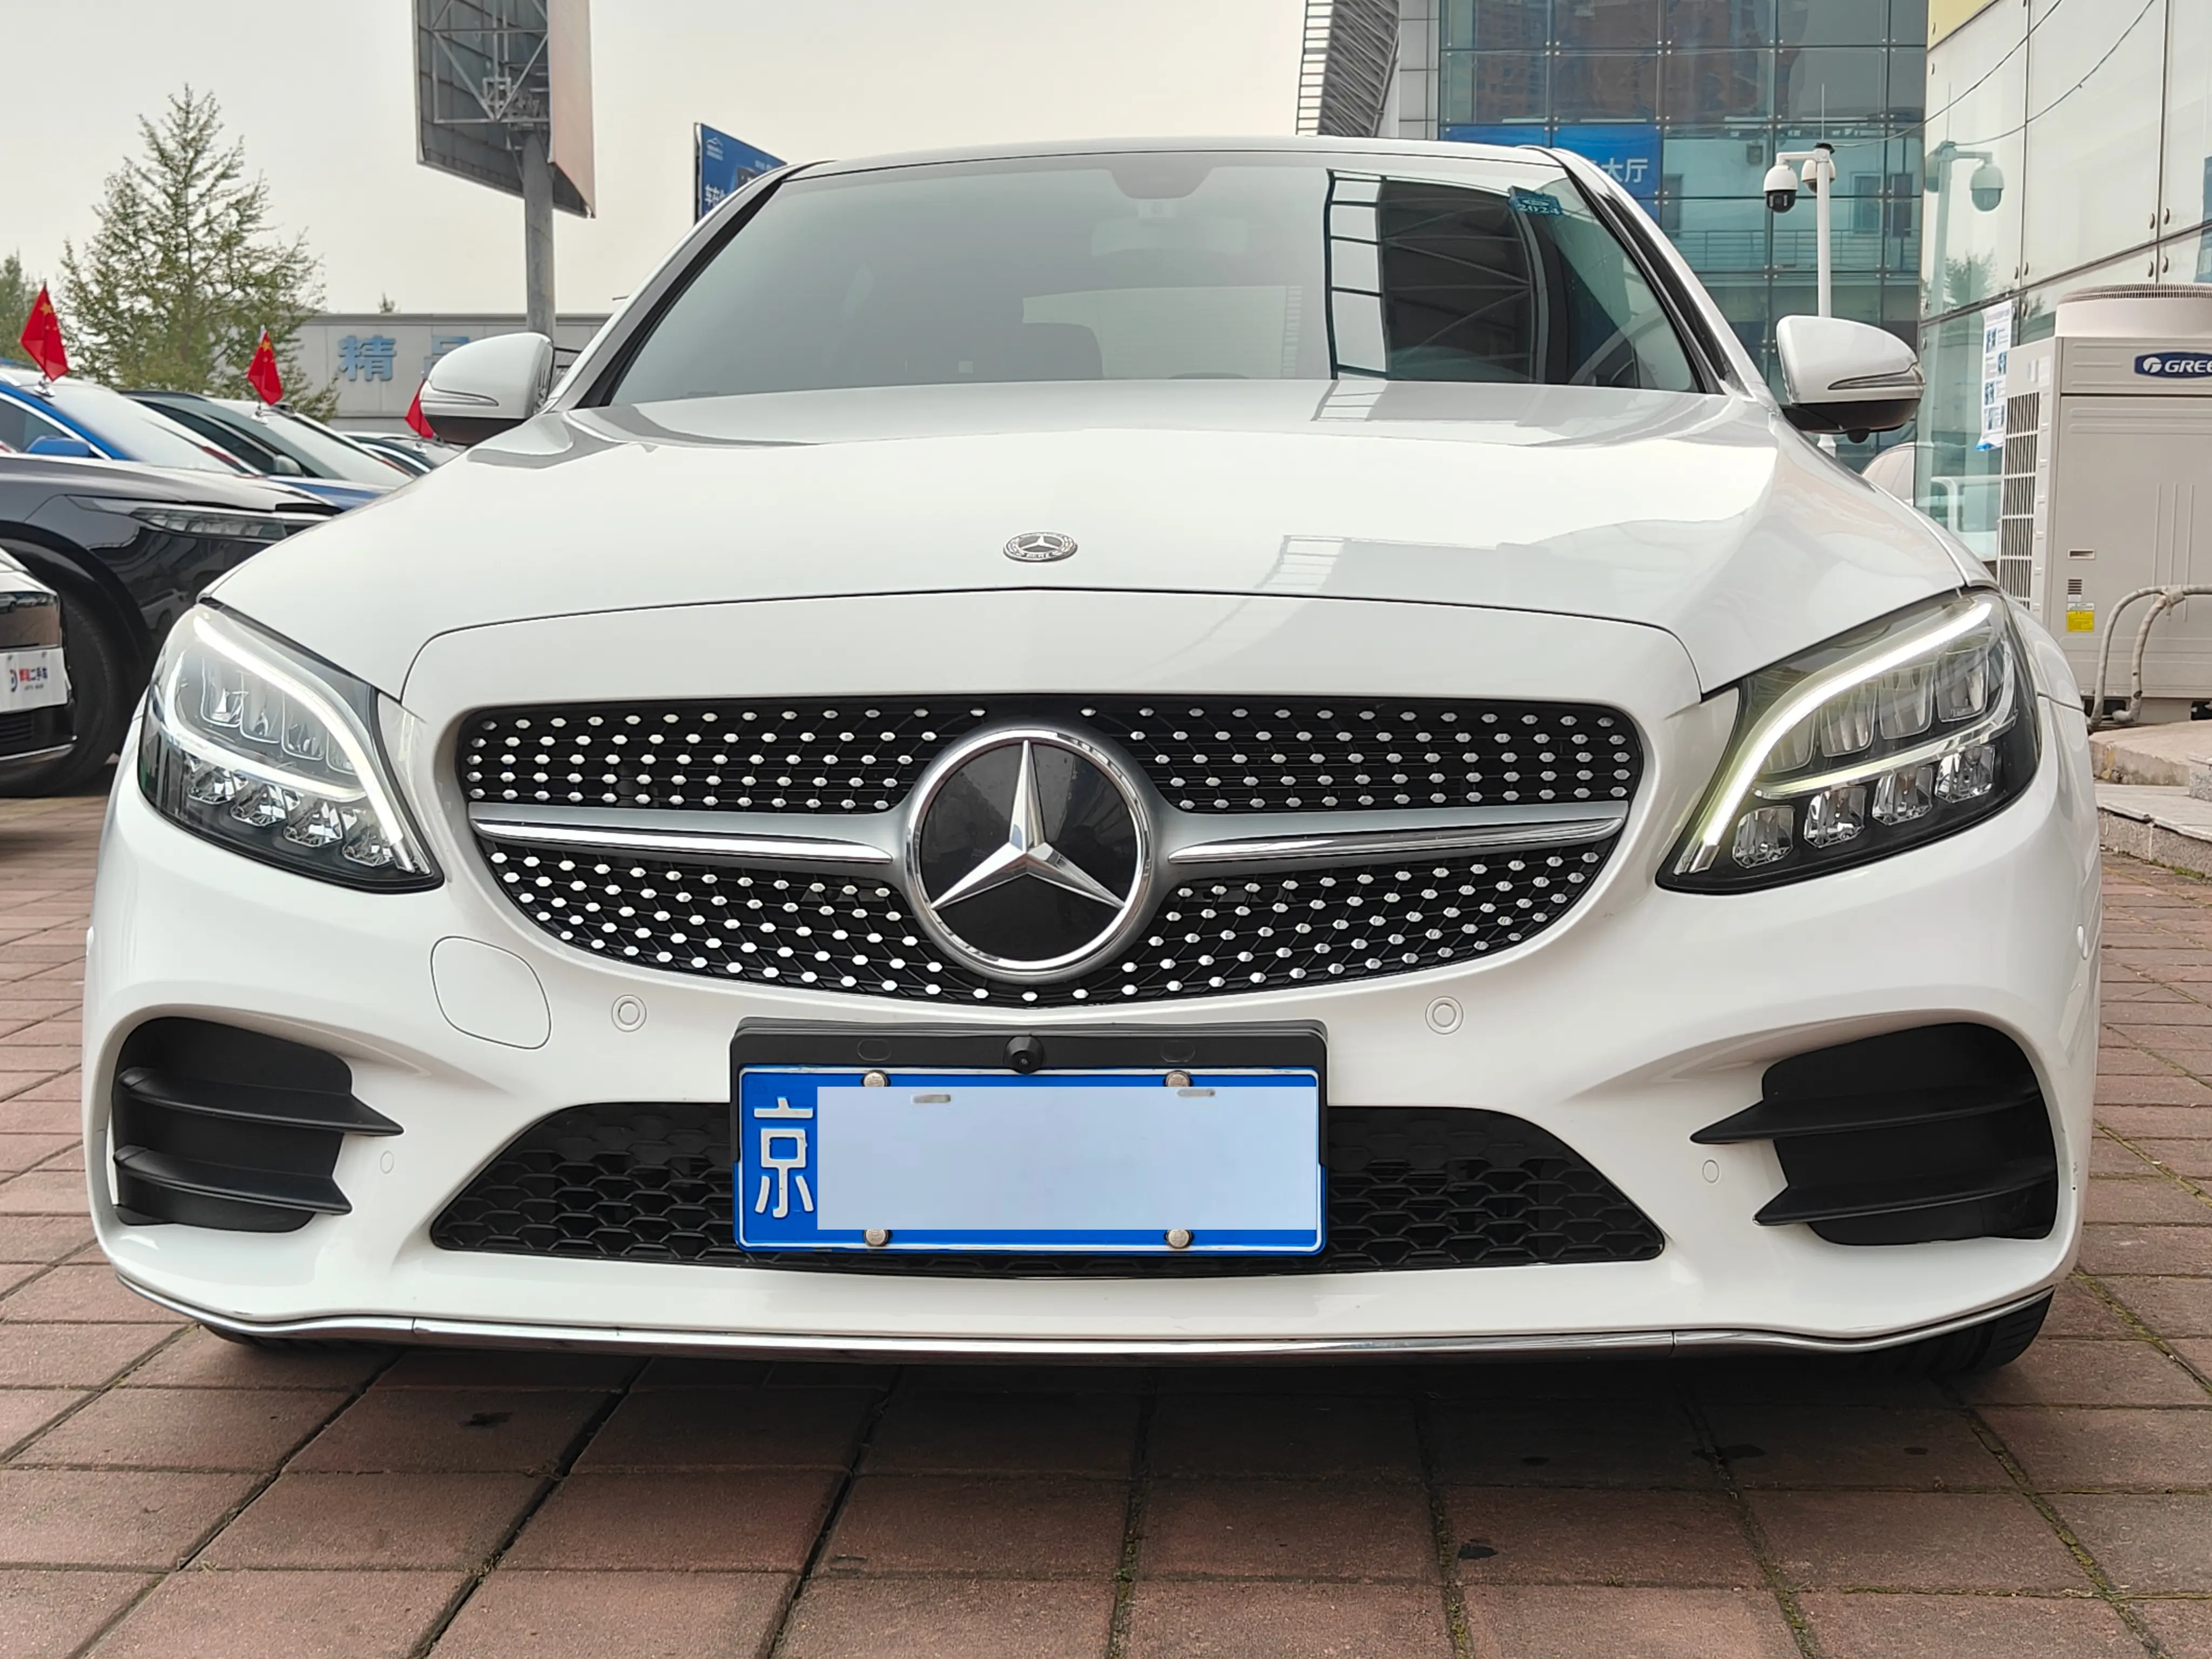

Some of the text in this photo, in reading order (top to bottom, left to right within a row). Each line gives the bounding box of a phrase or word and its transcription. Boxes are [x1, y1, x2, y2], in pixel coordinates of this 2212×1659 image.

[1589, 158, 1648, 183] 大厅
[1516, 204, 1560, 215] 2024
[754, 1096, 814, 1218] 京
